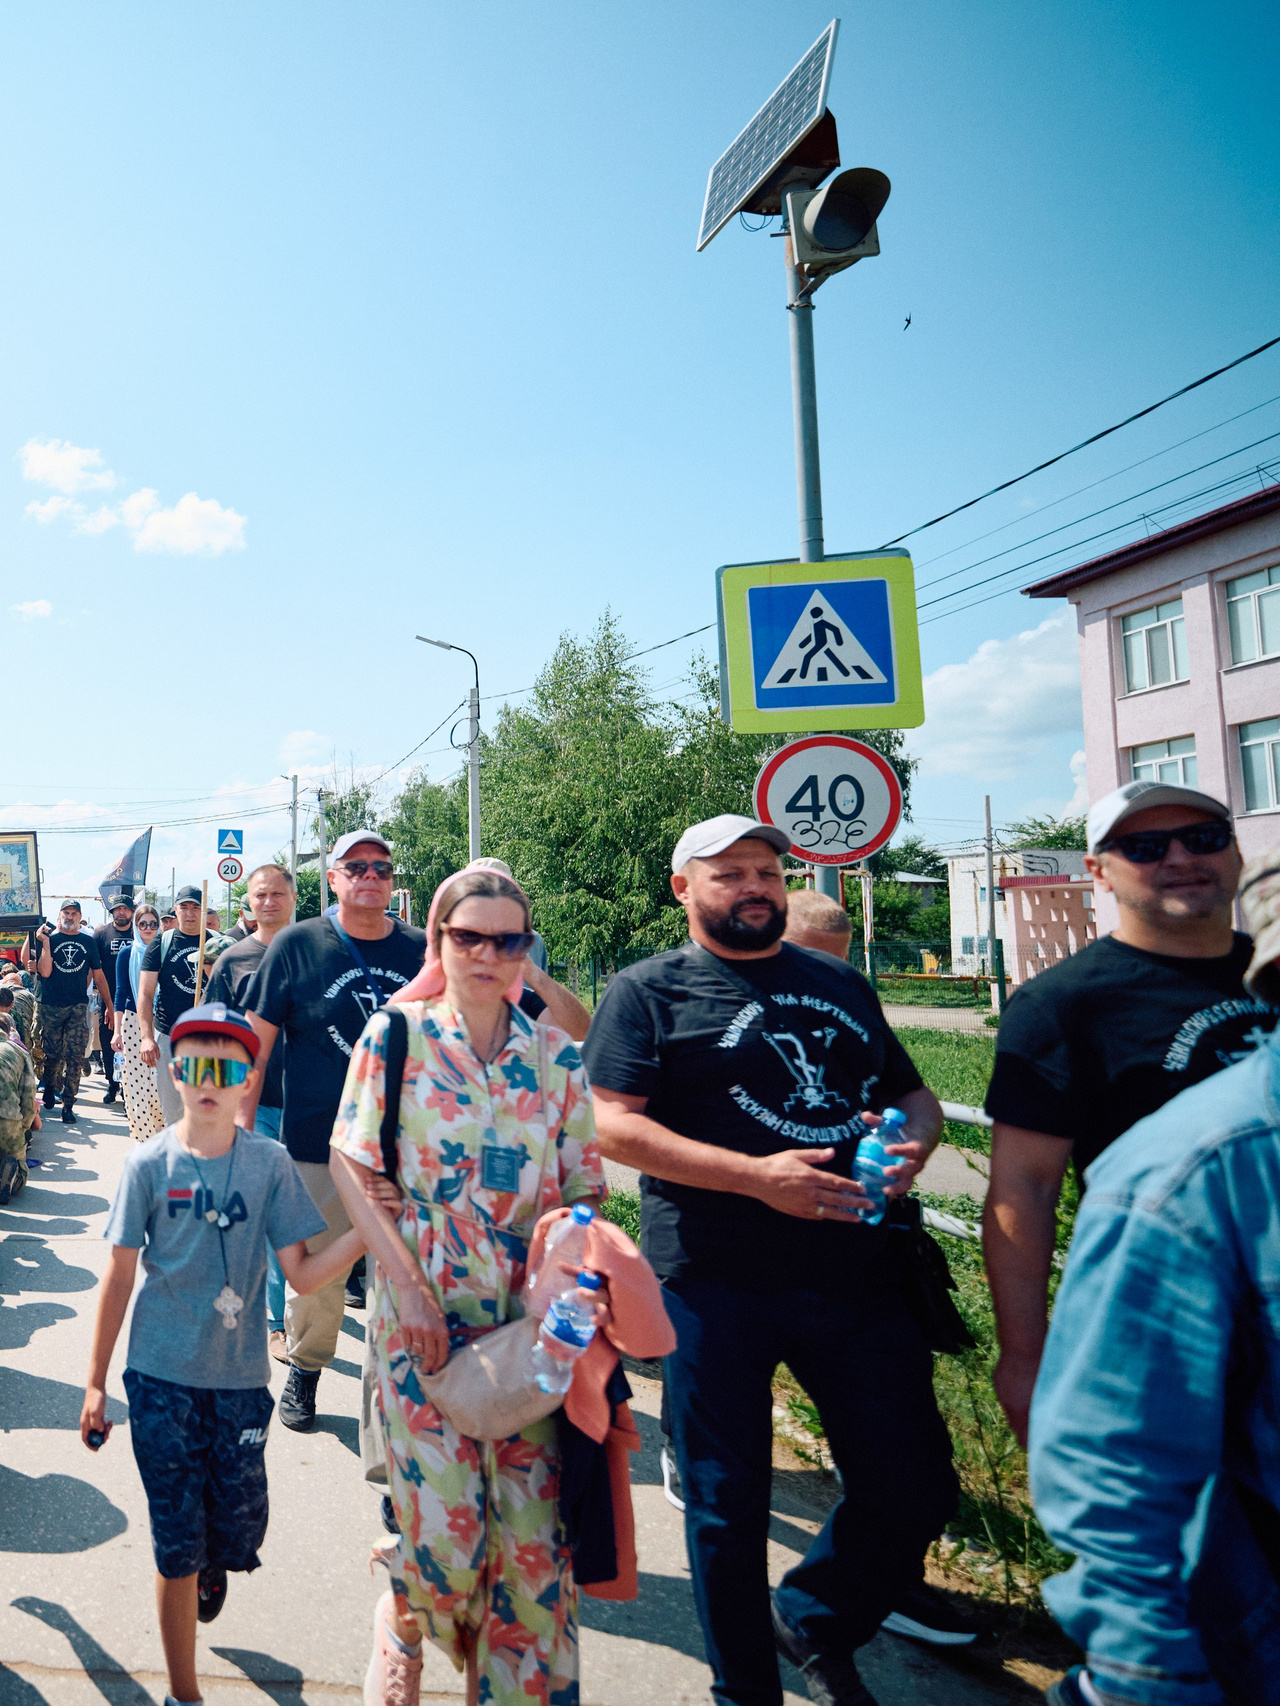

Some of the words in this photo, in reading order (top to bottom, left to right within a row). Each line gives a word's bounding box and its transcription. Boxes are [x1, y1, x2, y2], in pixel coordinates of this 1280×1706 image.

[785, 773, 865, 822] 40
[223, 864, 237, 875] 20
[167, 1188, 248, 1222] FILA
